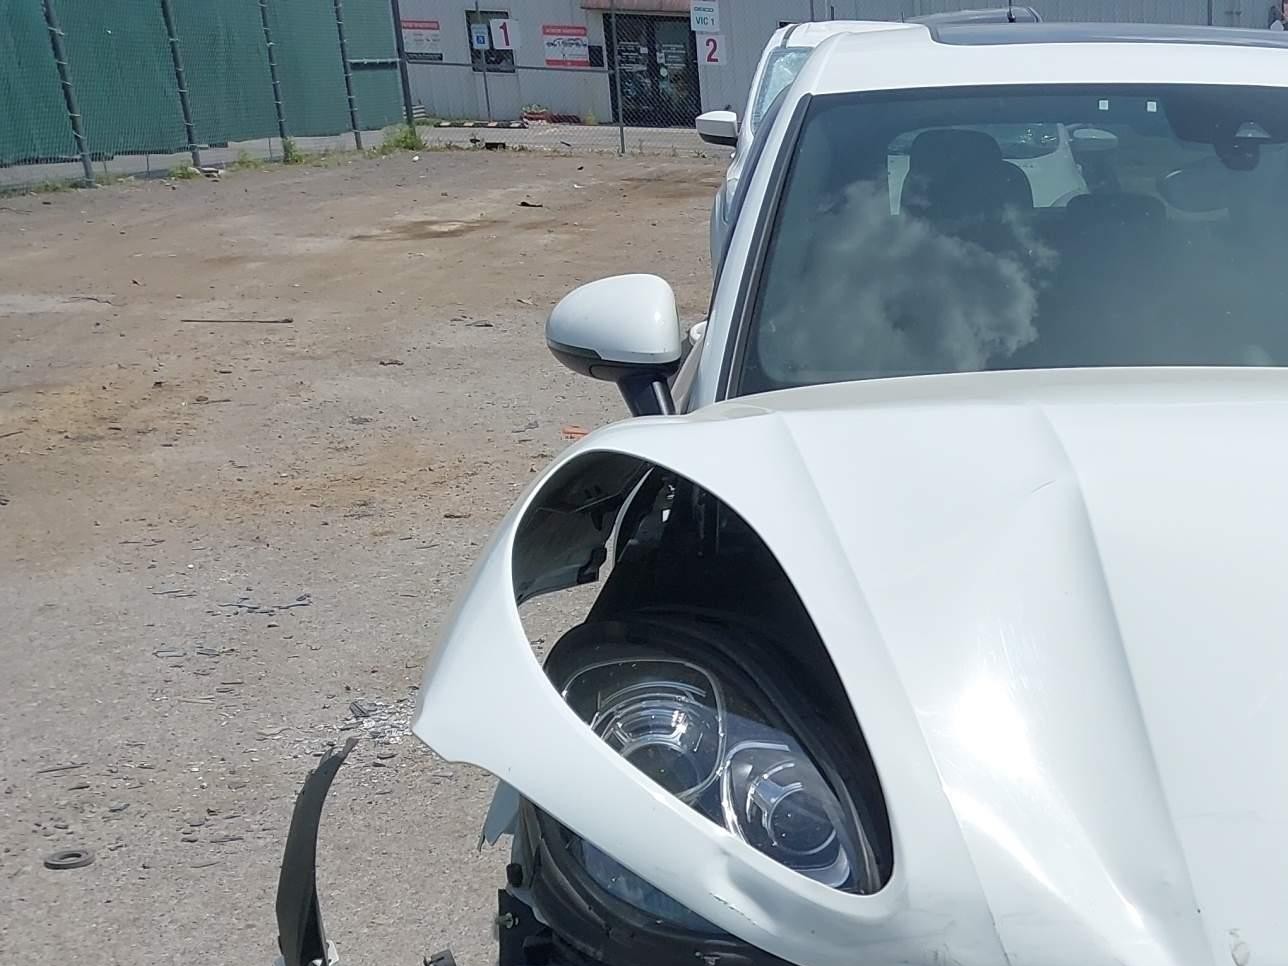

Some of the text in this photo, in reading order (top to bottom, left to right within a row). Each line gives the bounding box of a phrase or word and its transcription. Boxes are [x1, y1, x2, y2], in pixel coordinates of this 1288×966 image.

[696, 16, 708, 25] VIC
[499, 21, 510, 46] 1
[705, 38, 719, 62] 2
